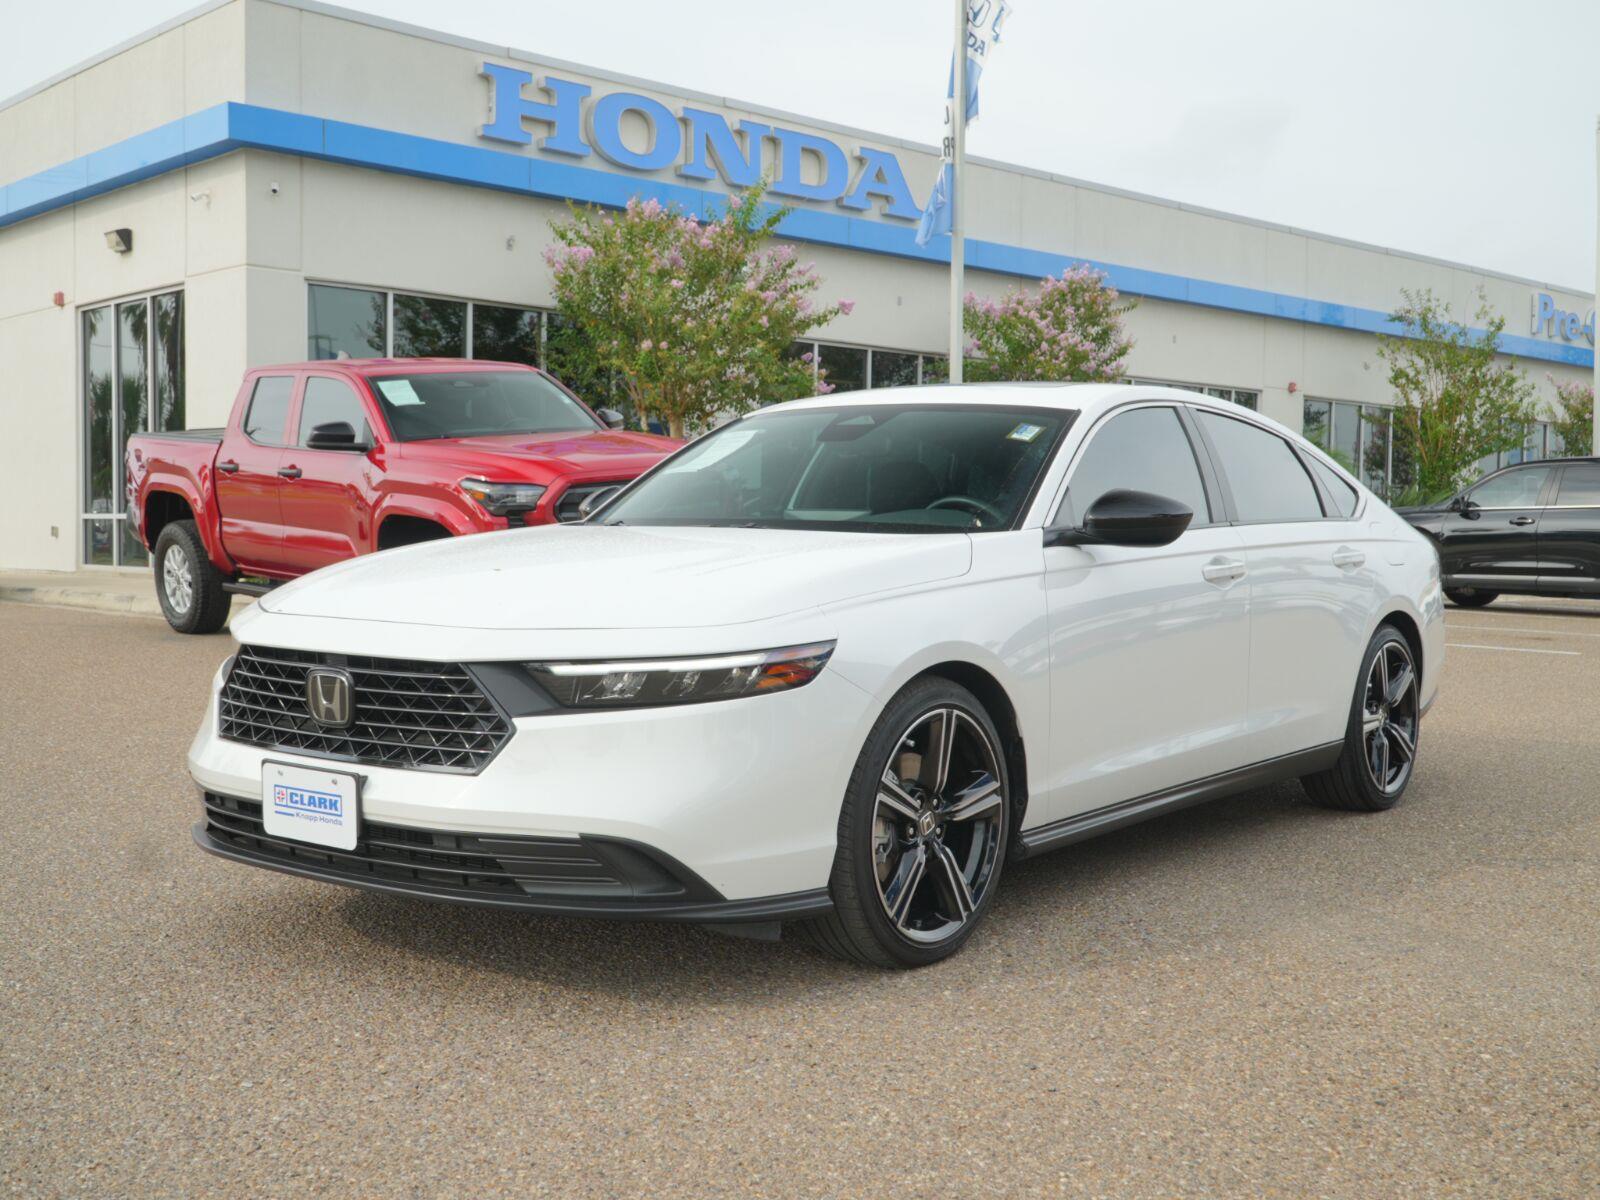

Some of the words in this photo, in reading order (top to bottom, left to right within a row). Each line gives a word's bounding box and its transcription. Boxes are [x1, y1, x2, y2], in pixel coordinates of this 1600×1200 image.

[478, 62, 922, 220] HONDA
[1532, 292, 1595, 346] Pre-
[289, 792, 339, 811] CLARK
[295, 812, 318, 823] Knapp
[319, 816, 343, 826] Honda
